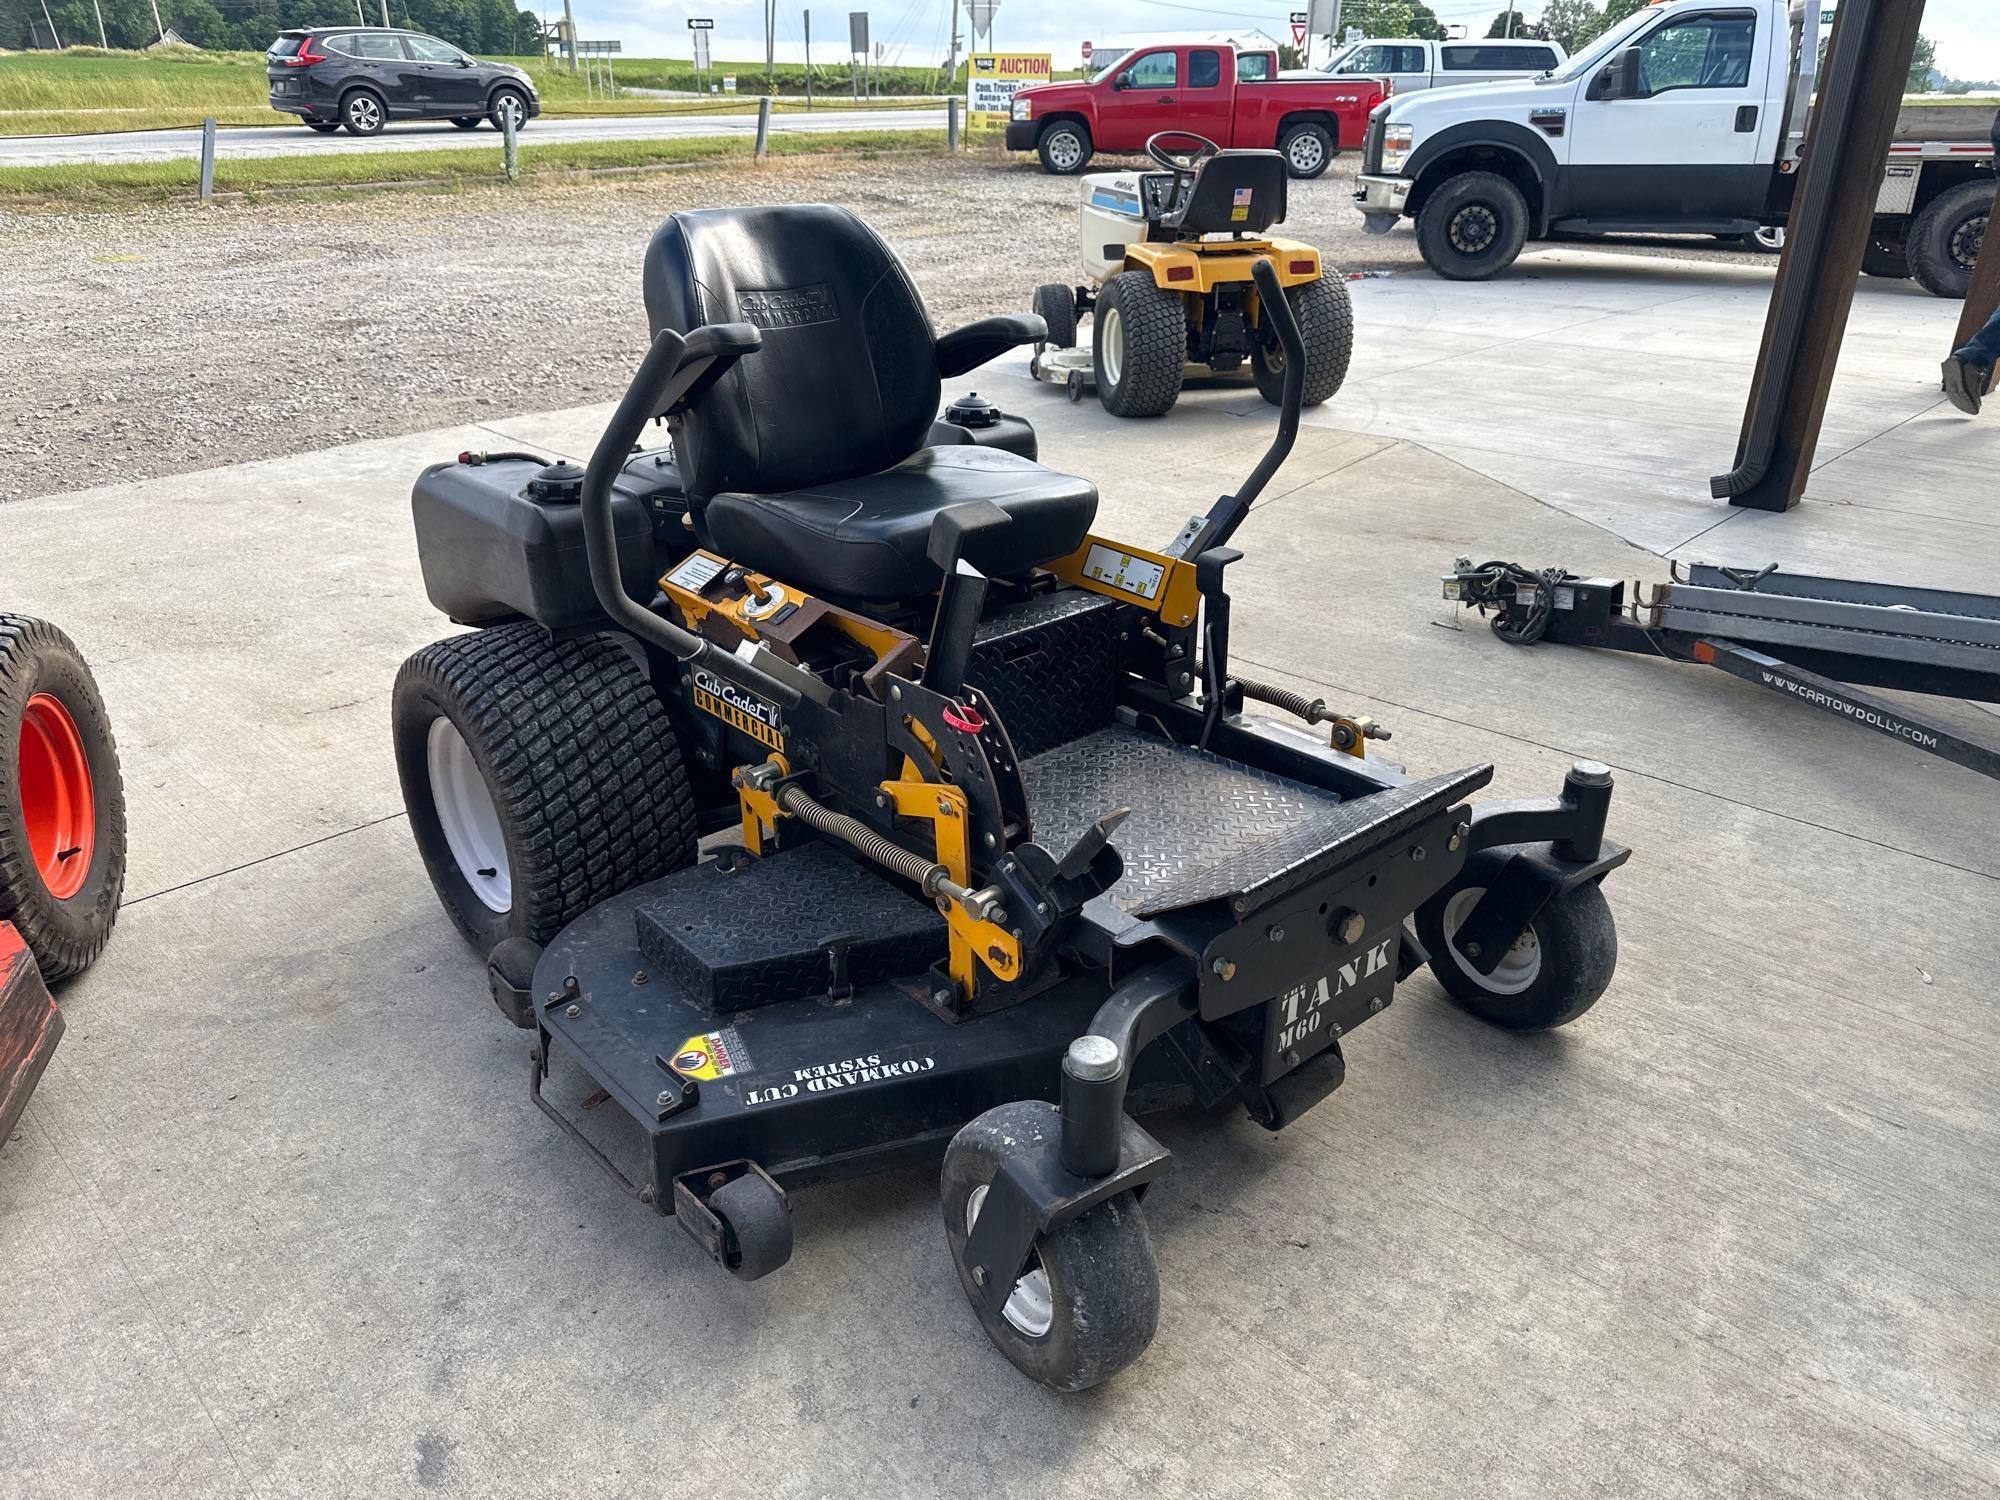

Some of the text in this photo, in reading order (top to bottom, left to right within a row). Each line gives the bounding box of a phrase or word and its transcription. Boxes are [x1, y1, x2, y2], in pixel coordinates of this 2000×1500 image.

[994, 82, 1017, 93] Trucks
[1000, 58, 1049, 74] AUCTION
[694, 671, 768, 722] Cub Cadet
[1762, 671, 1938, 749] WWW.CARTOWDOLLY.COM
[696, 689, 782, 750] COMMERCIAL
[1281, 939, 1391, 1027] TANK
[711, 1037, 731, 1069] DANGER
[1278, 1011, 1321, 1053] M60
[745, 1057, 935, 1106] COMMAND CUT
[793, 1054, 881, 1081] SYSTEM
